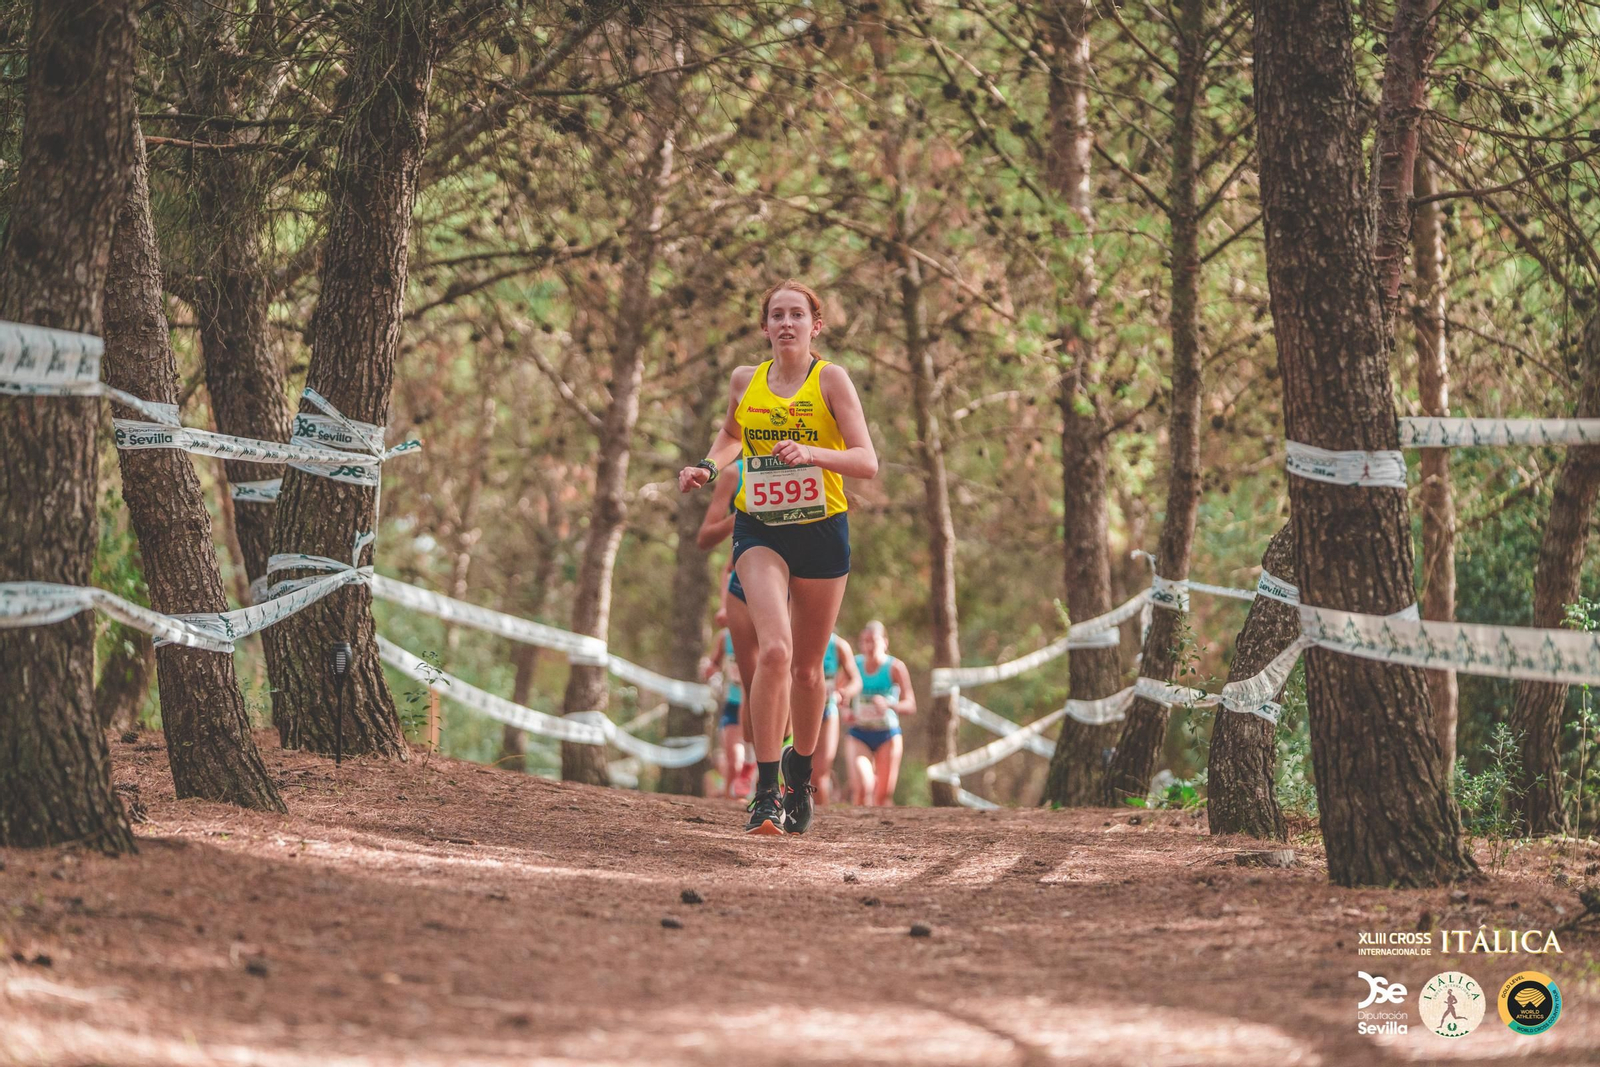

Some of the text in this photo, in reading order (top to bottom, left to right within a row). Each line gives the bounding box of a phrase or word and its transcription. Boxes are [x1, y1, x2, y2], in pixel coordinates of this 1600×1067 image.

[129, 433, 173, 446] Sevilla
[318, 431, 353, 444] Sevilla
[749, 429, 819, 442] SCORPIO-71
[754, 478, 819, 506] 5593
